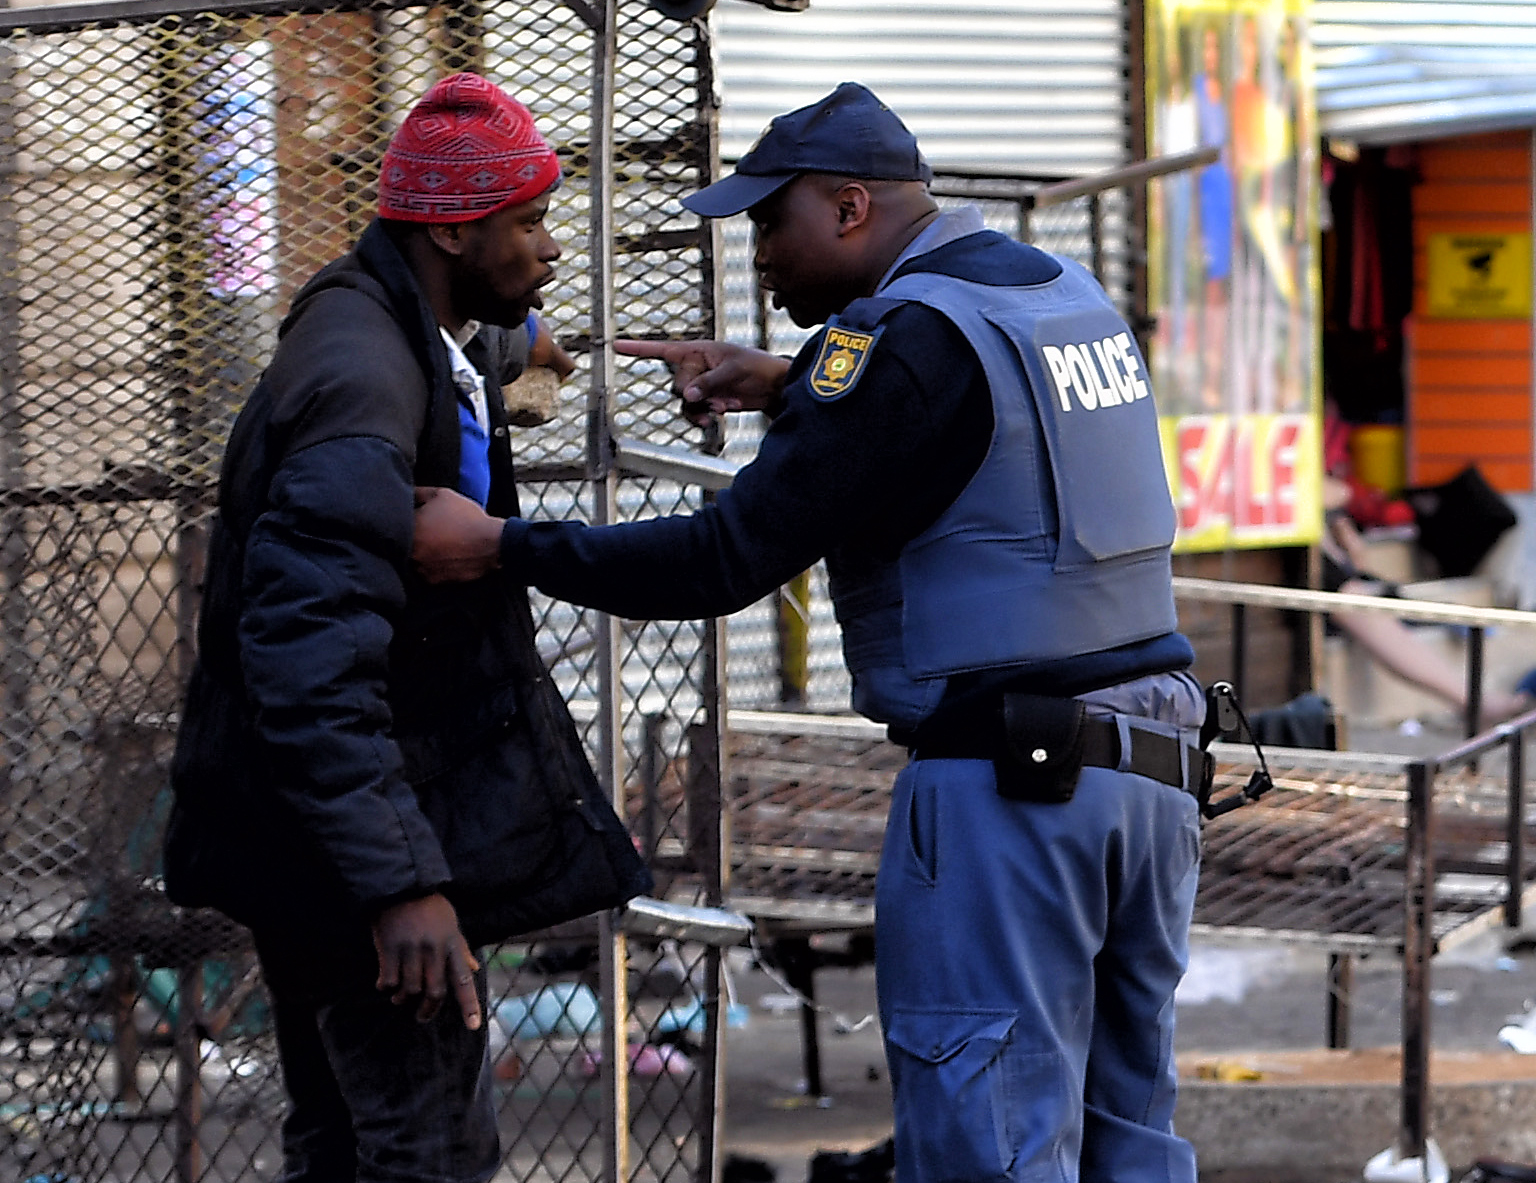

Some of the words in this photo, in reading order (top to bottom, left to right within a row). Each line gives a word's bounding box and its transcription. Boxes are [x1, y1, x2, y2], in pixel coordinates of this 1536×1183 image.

[828, 331, 869, 352] POLICE
[1041, 331, 1149, 412] POLICE
[1175, 415, 1304, 535] SALE
